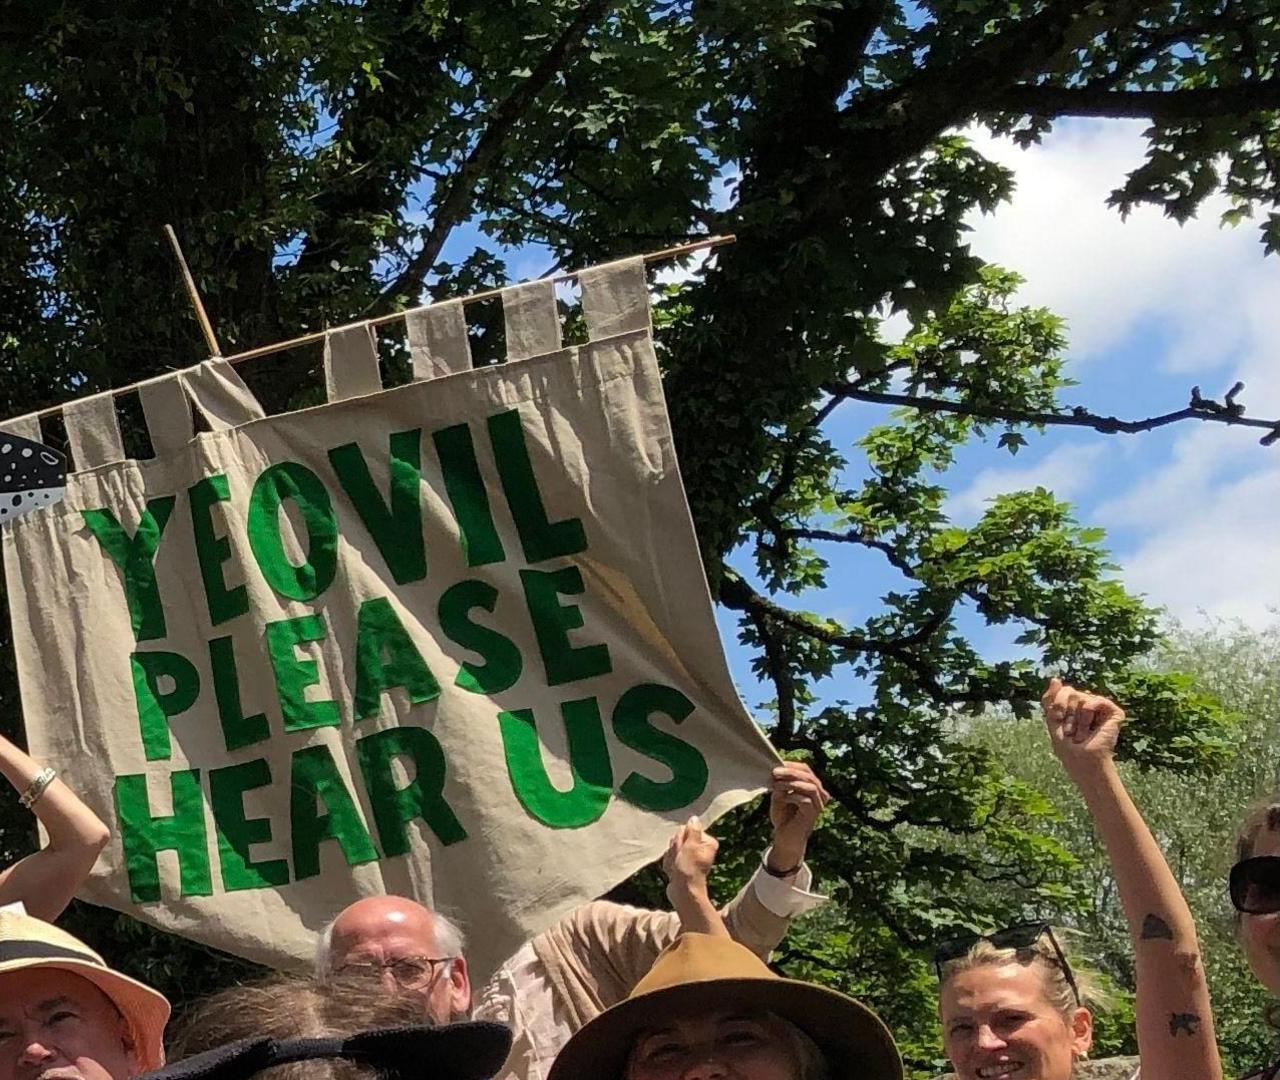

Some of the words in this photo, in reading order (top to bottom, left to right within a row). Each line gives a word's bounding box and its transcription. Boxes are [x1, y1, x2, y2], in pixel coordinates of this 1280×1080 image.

[82, 408, 588, 640] YEOVIL
[130, 566, 612, 762] PLEASE
[114, 727, 468, 904] HEAR
[498, 682, 710, 830] US
